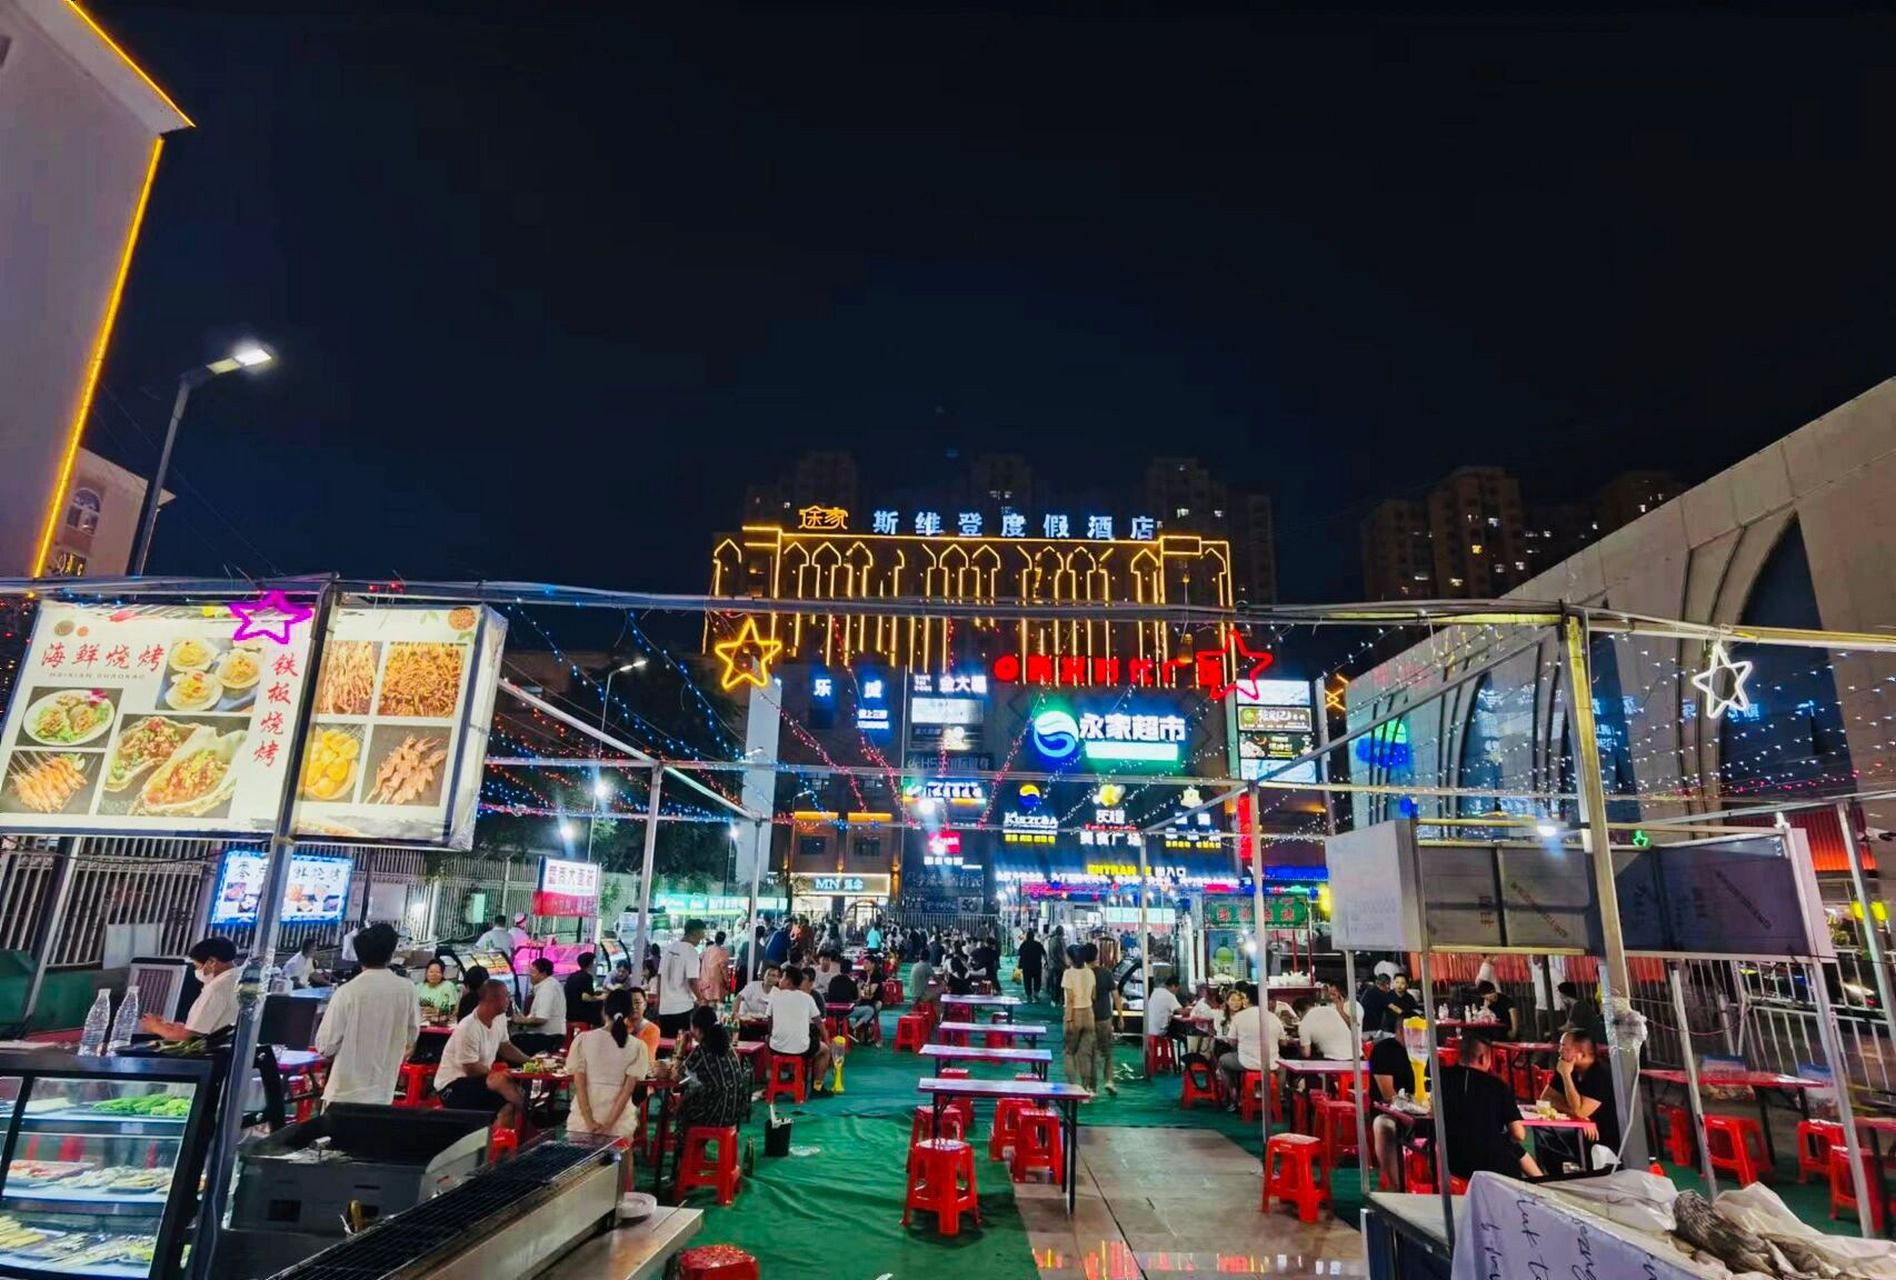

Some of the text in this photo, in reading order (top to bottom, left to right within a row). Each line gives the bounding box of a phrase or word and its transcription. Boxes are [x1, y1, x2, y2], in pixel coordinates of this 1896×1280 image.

[798, 505, 848, 530] 途家
[873, 510, 1155, 540] 斯维登度假酒店
[41, 643, 165, 672] 海鲜烧烤
[254, 653, 299, 767] 铁板烧烤
[815, 878, 840, 890] MN
